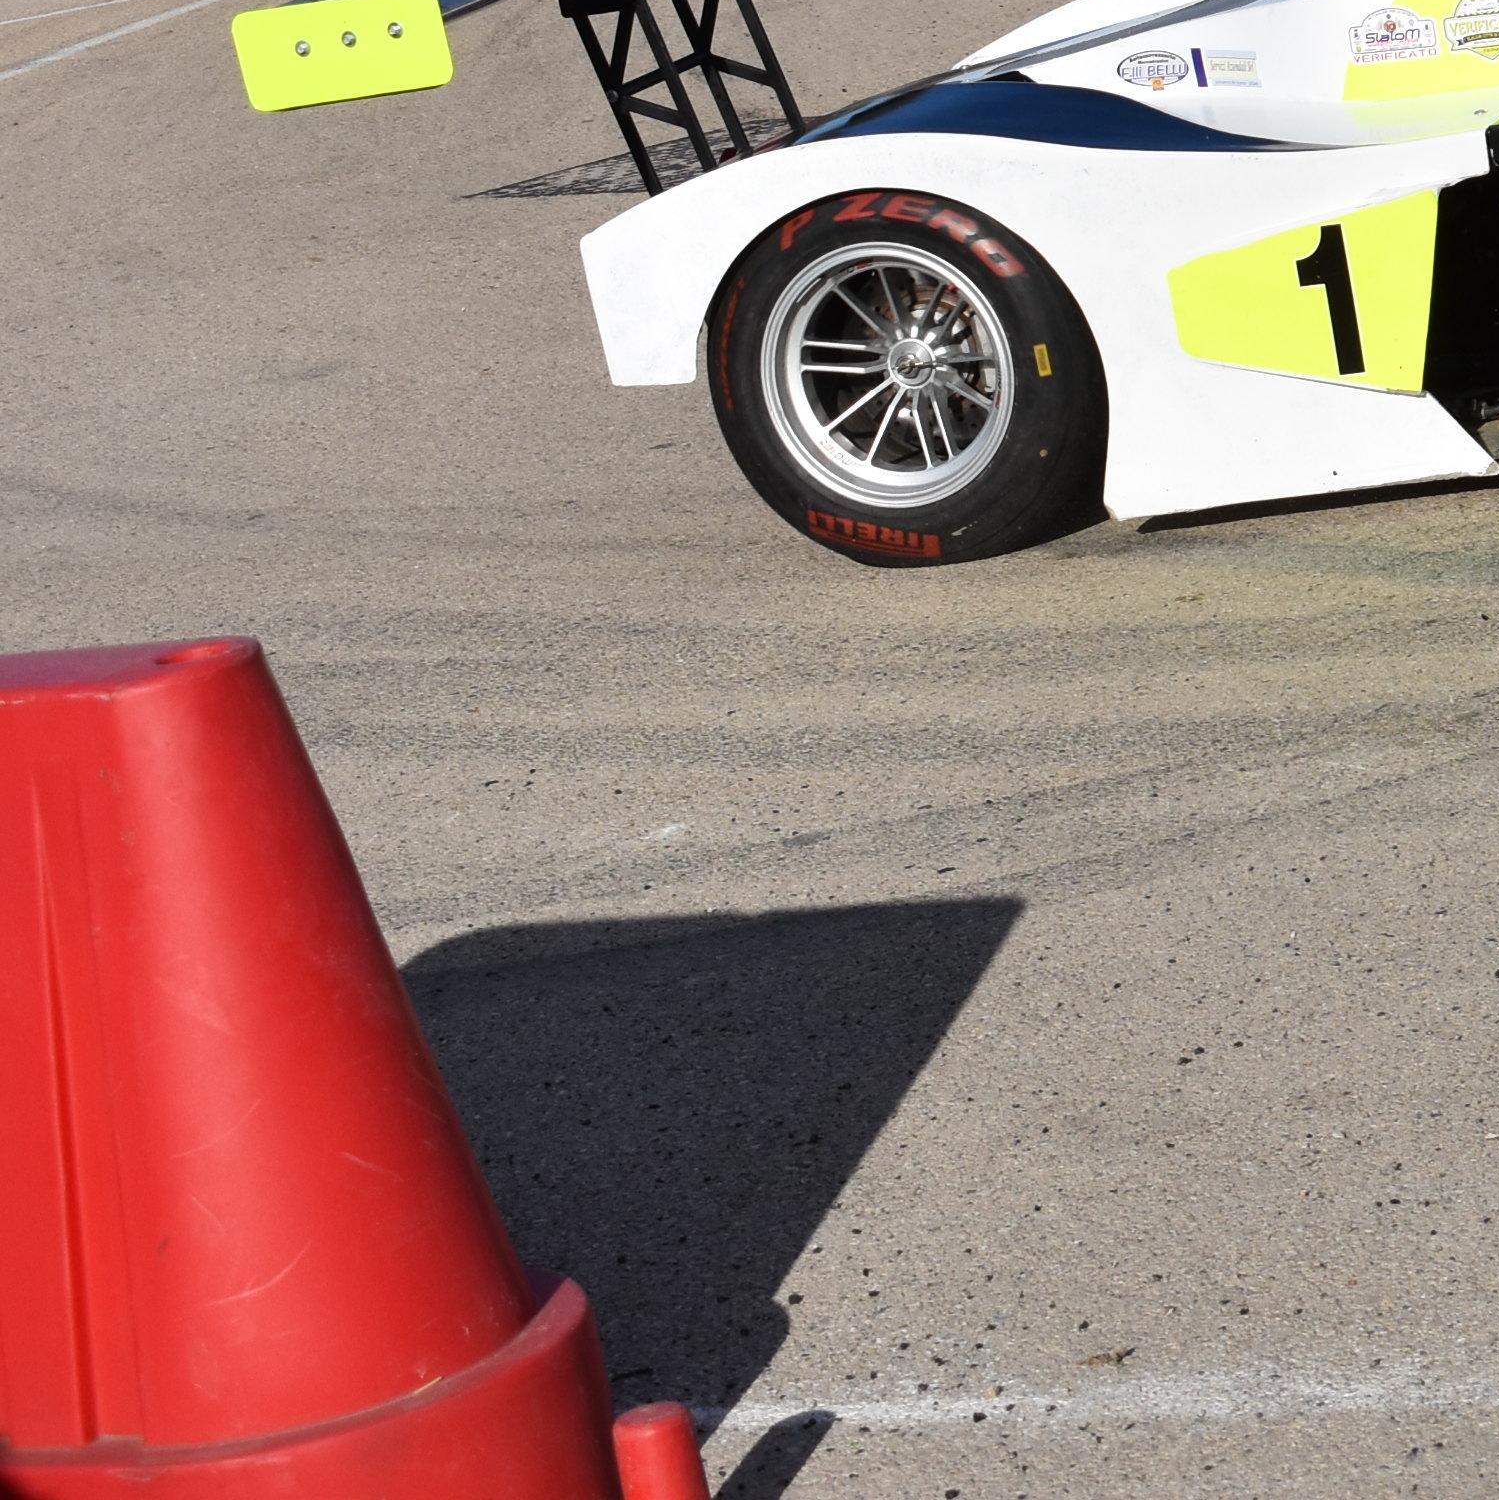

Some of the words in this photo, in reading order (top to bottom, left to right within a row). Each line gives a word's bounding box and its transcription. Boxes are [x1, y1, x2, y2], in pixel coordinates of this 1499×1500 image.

[1353, 47, 1437, 64] VERIFICATO
[779, 208, 816, 251] P
[831, 191, 1028, 278] ZERO
[1295, 223, 1366, 376] 1
[806, 508, 942, 559] PIRELLI
